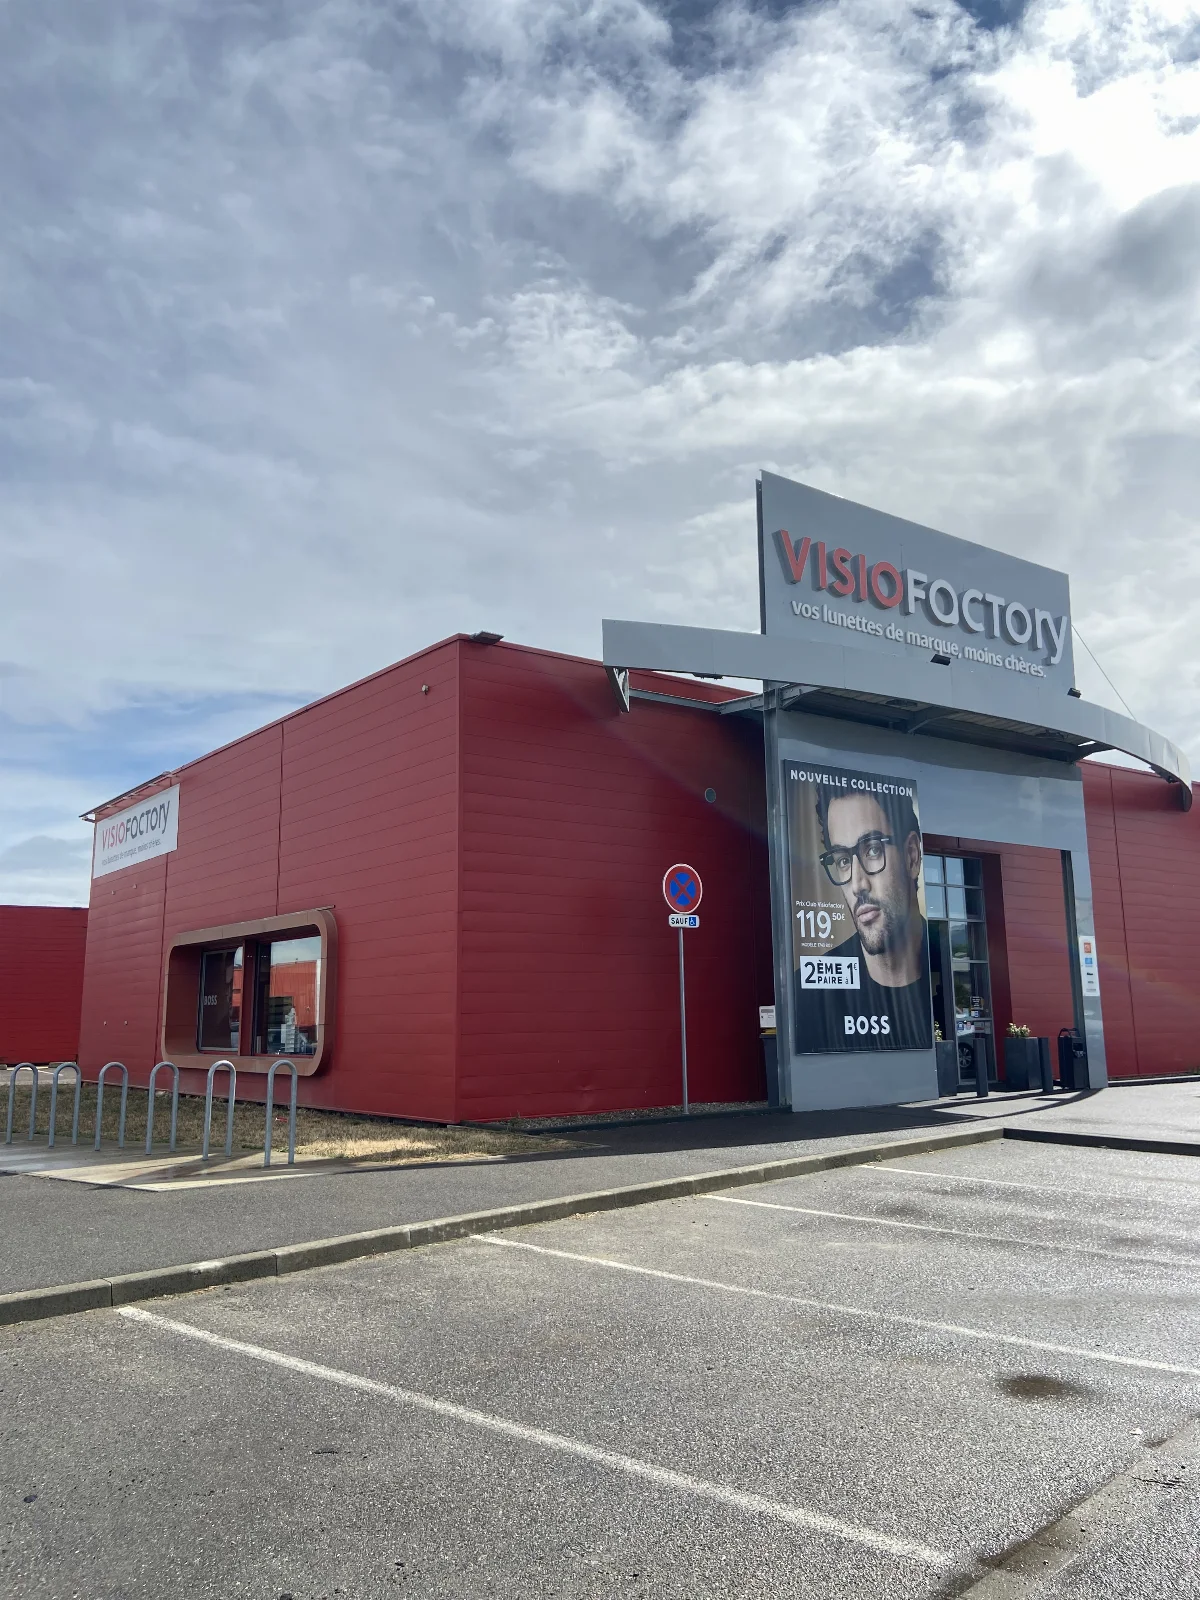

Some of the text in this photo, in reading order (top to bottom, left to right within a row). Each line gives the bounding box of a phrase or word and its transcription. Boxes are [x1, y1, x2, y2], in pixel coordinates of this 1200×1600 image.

[791, 600, 1047, 678] vos lunettes de marque, moins chères.
[790, 769, 913, 797] NOUVELLE COLLECTION
[670, 917, 688, 925] SAUF
[817, 976, 843, 985] PAIRE
[843, 1015, 891, 1035] BOSS
